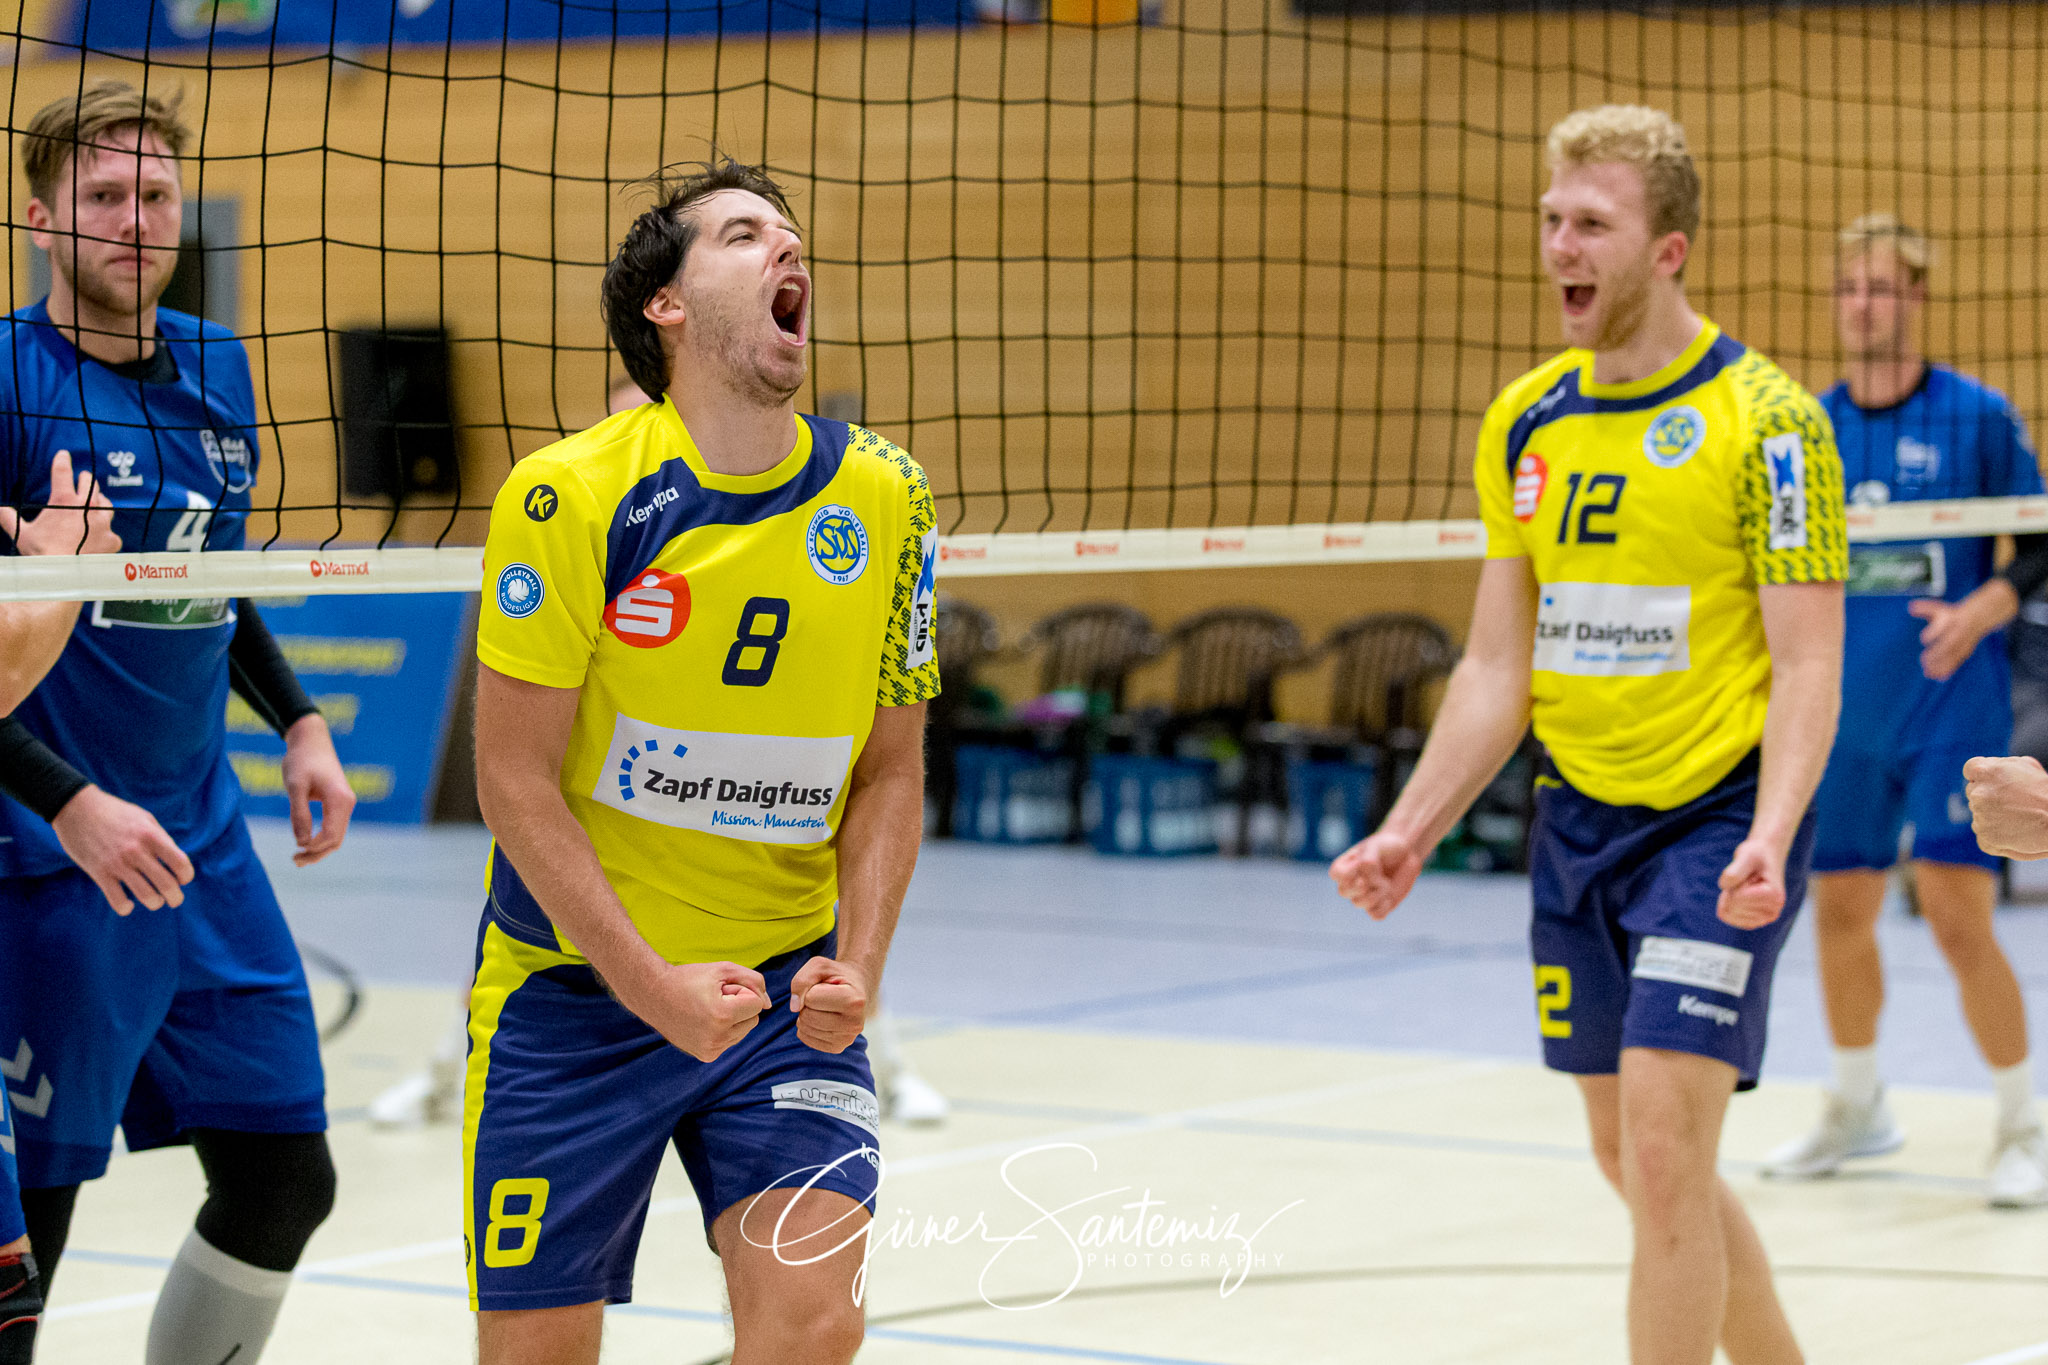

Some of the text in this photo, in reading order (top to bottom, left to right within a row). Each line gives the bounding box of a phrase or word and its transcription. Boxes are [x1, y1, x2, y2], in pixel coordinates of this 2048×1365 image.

[166, 490, 213, 552] 4
[1558, 473, 1627, 544] 12
[139, 564, 188, 580] Marmot
[323, 561, 369, 577] Marmot
[503, 570, 538, 591] VOLLEYBALL
[501, 592, 535, 612] BUNDESLIGA
[721, 596, 790, 687] 8
[643, 768, 833, 809] Zapf Daigfuss
[711, 810, 825, 829] Mission: Mauerstein
[484, 1177, 550, 1268] 8
